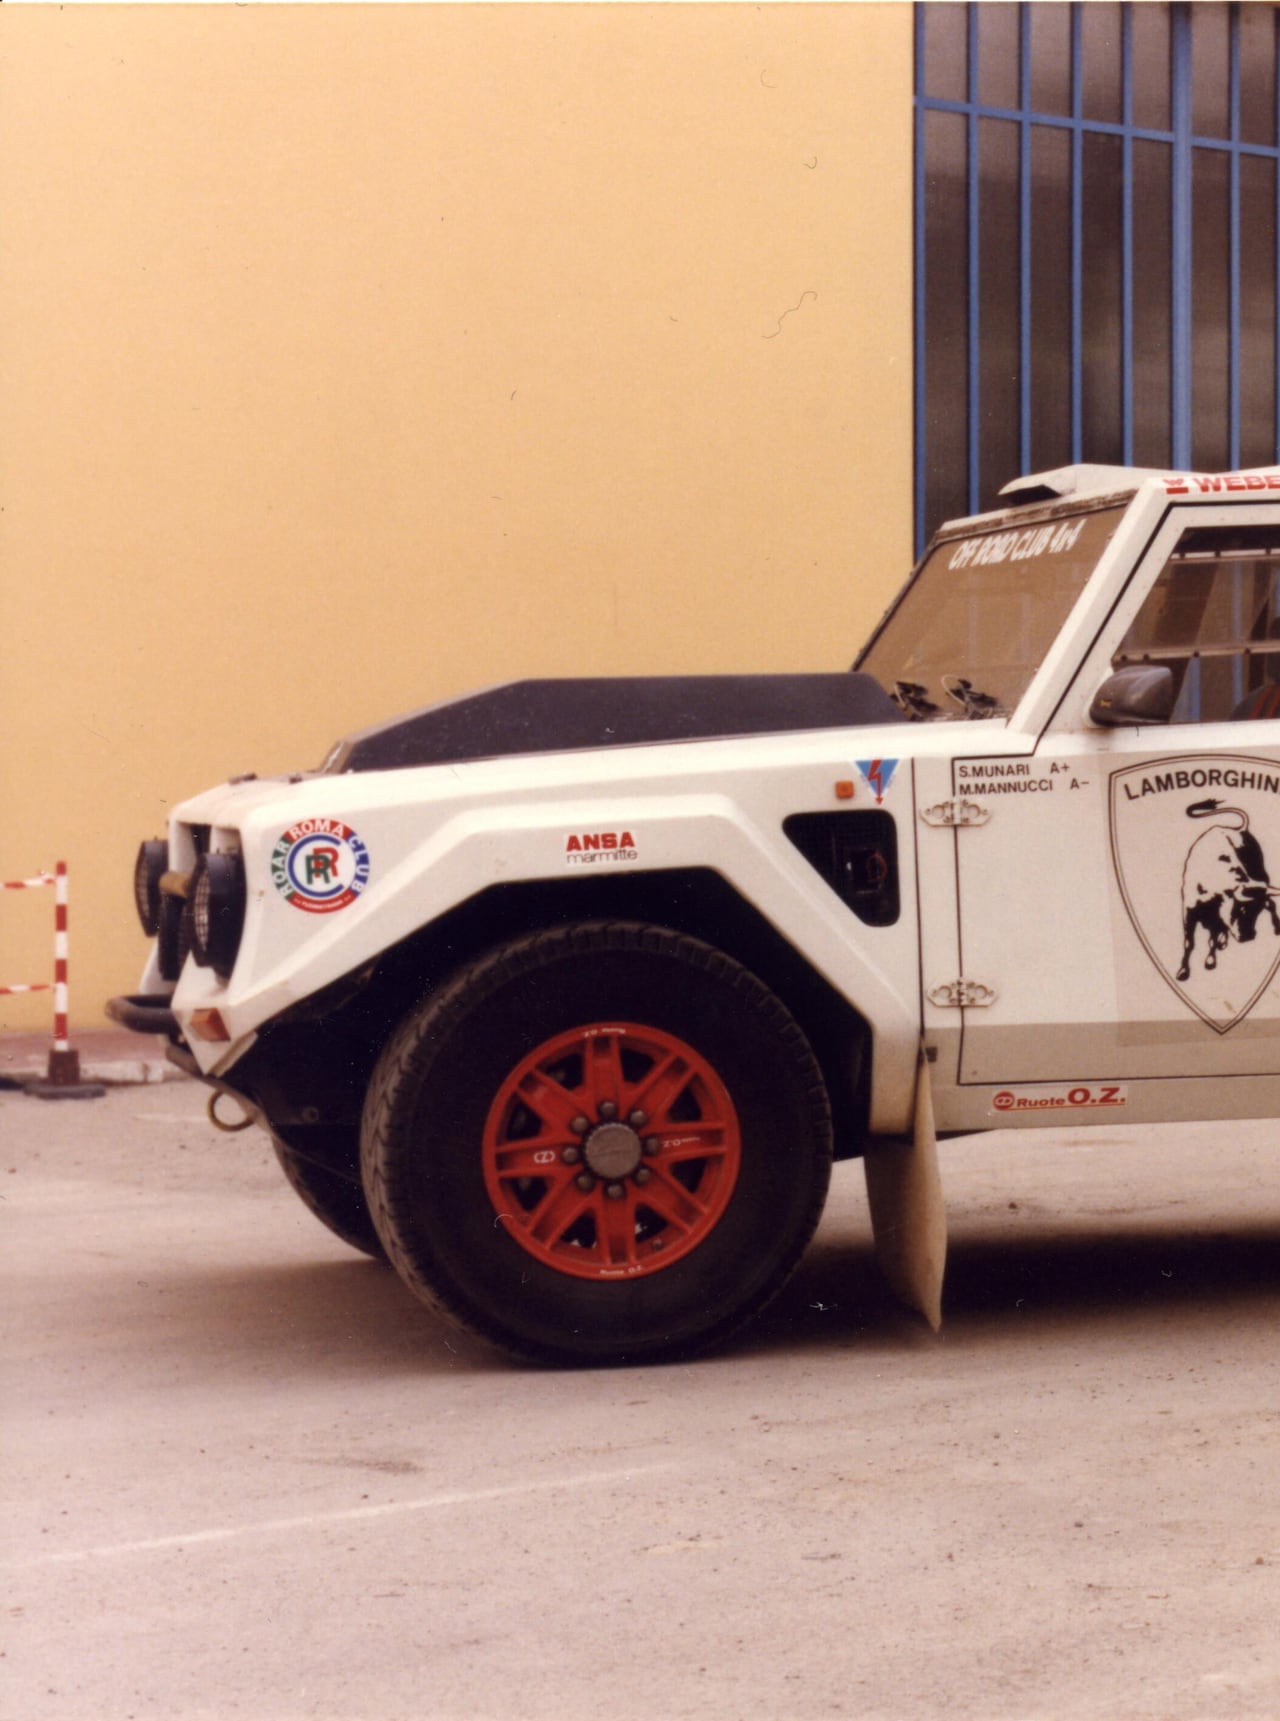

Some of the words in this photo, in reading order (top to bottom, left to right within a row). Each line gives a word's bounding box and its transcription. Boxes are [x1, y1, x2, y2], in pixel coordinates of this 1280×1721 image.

[959, 764, 1031, 778] S.MUNARI
[959, 779, 1053, 796] M.MANNUCCI
[566, 831, 635, 852] ANSA
[271, 840, 295, 898] ROAR
[289, 819, 345, 841] ROMA
[348, 835, 370, 893] CLUB
[566, 848, 638, 864] marmitte
[1016, 1097, 1066, 1108] Ruote
